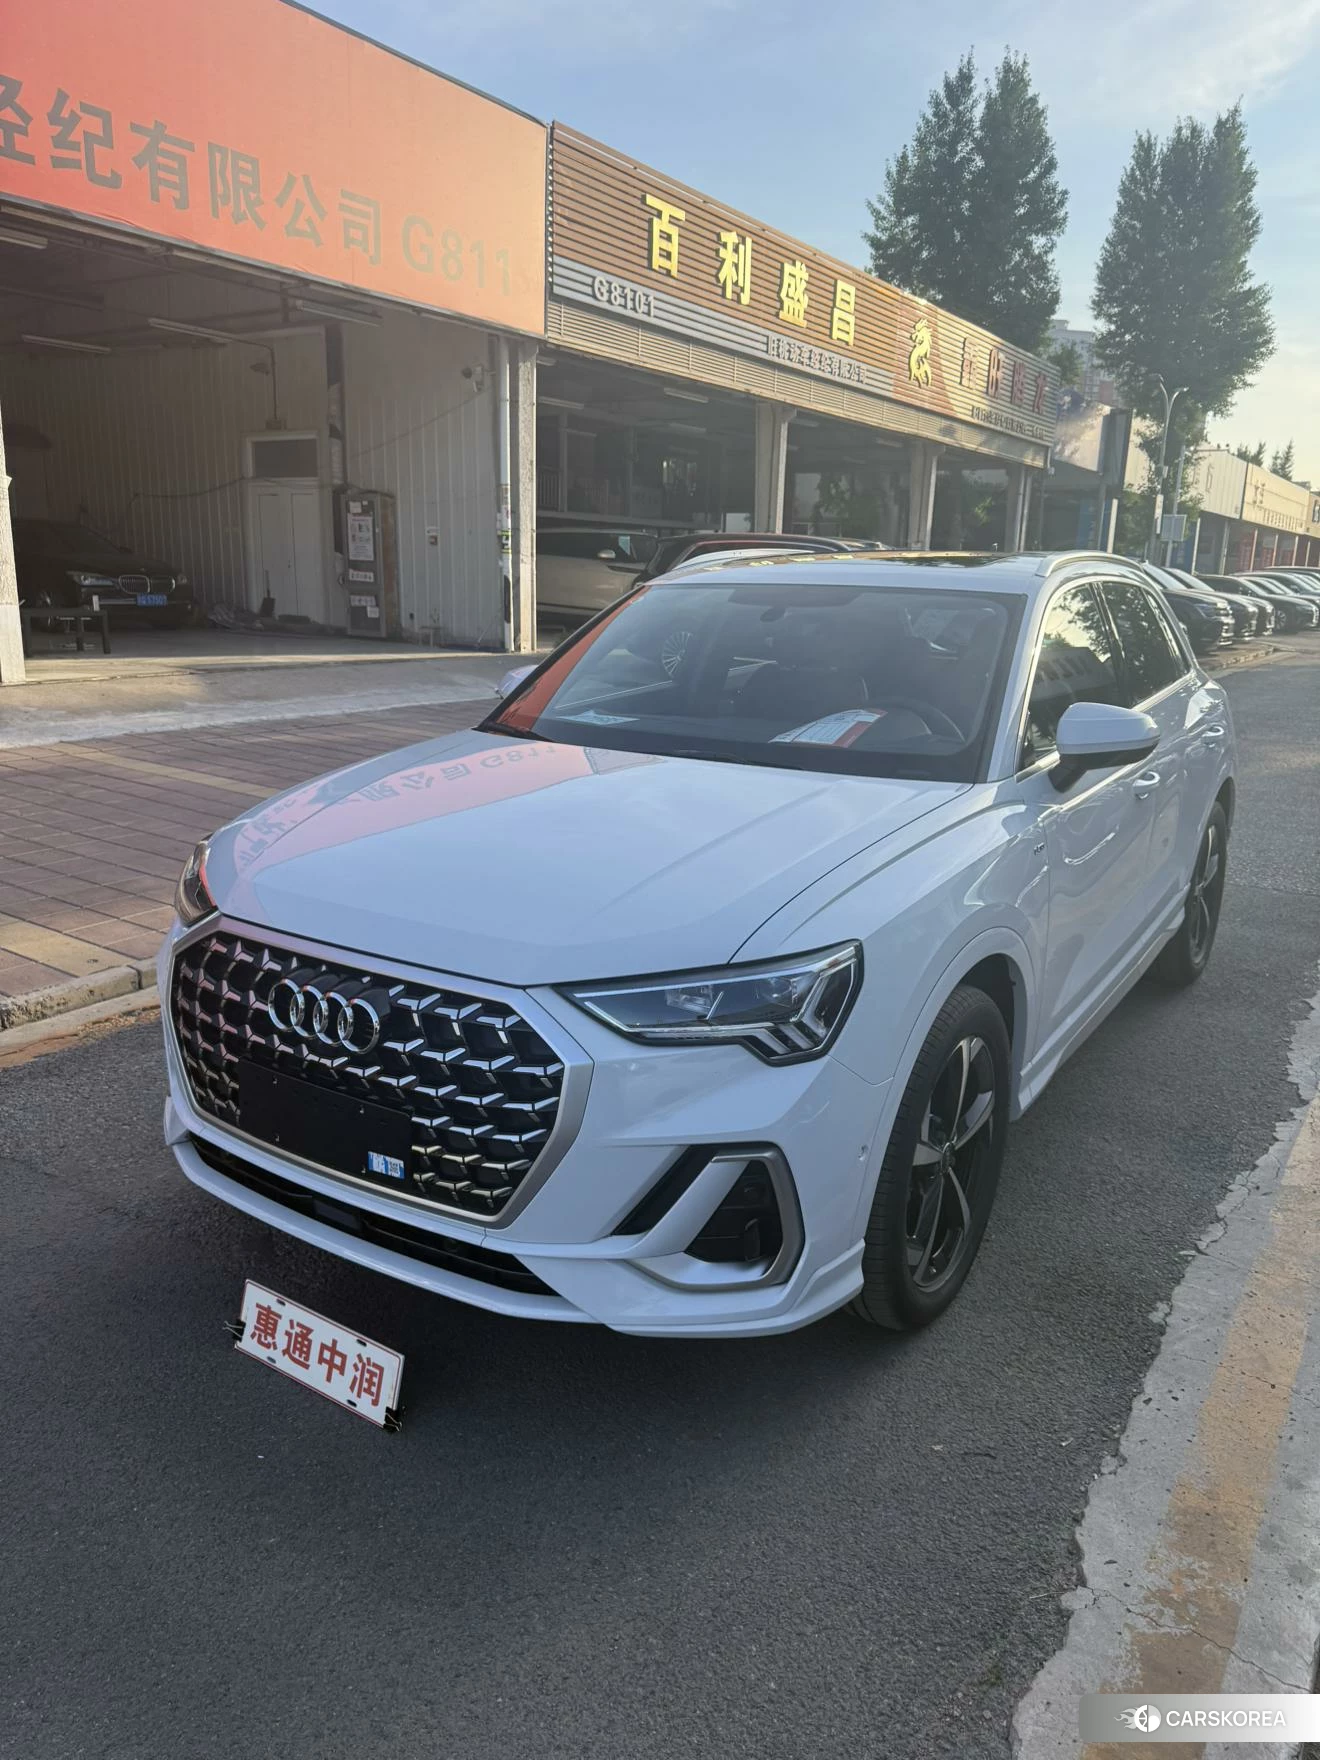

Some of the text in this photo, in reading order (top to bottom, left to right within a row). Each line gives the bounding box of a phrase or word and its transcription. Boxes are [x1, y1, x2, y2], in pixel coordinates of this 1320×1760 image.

[402, 215, 511, 296] G811
[594, 276, 655, 318] G8101
[645, 193, 855, 346] 百利盛昌
[251, 1302, 385, 1407] 惠通中润
